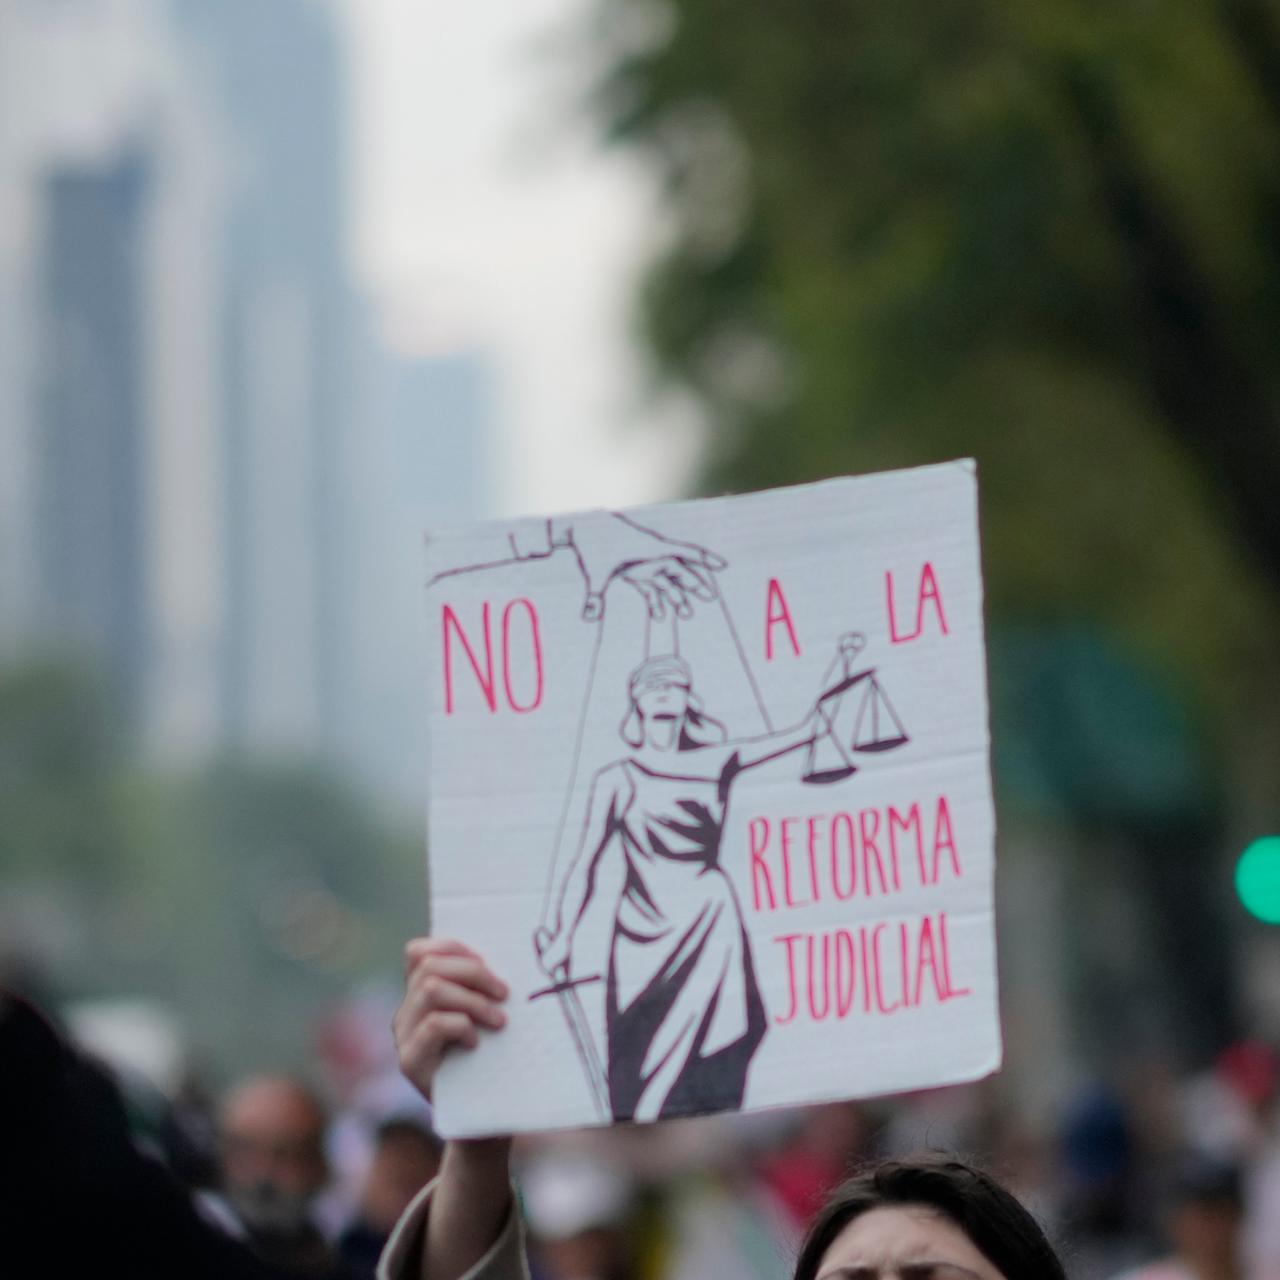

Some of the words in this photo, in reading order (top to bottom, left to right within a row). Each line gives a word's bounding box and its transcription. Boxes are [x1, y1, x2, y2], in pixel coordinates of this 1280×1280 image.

[442, 598, 544, 715] NO
[765, 577, 800, 660] A
[885, 561, 949, 645] LA
[749, 795, 961, 911] REFORMA
[773, 911, 970, 1026] JUDICIAL
